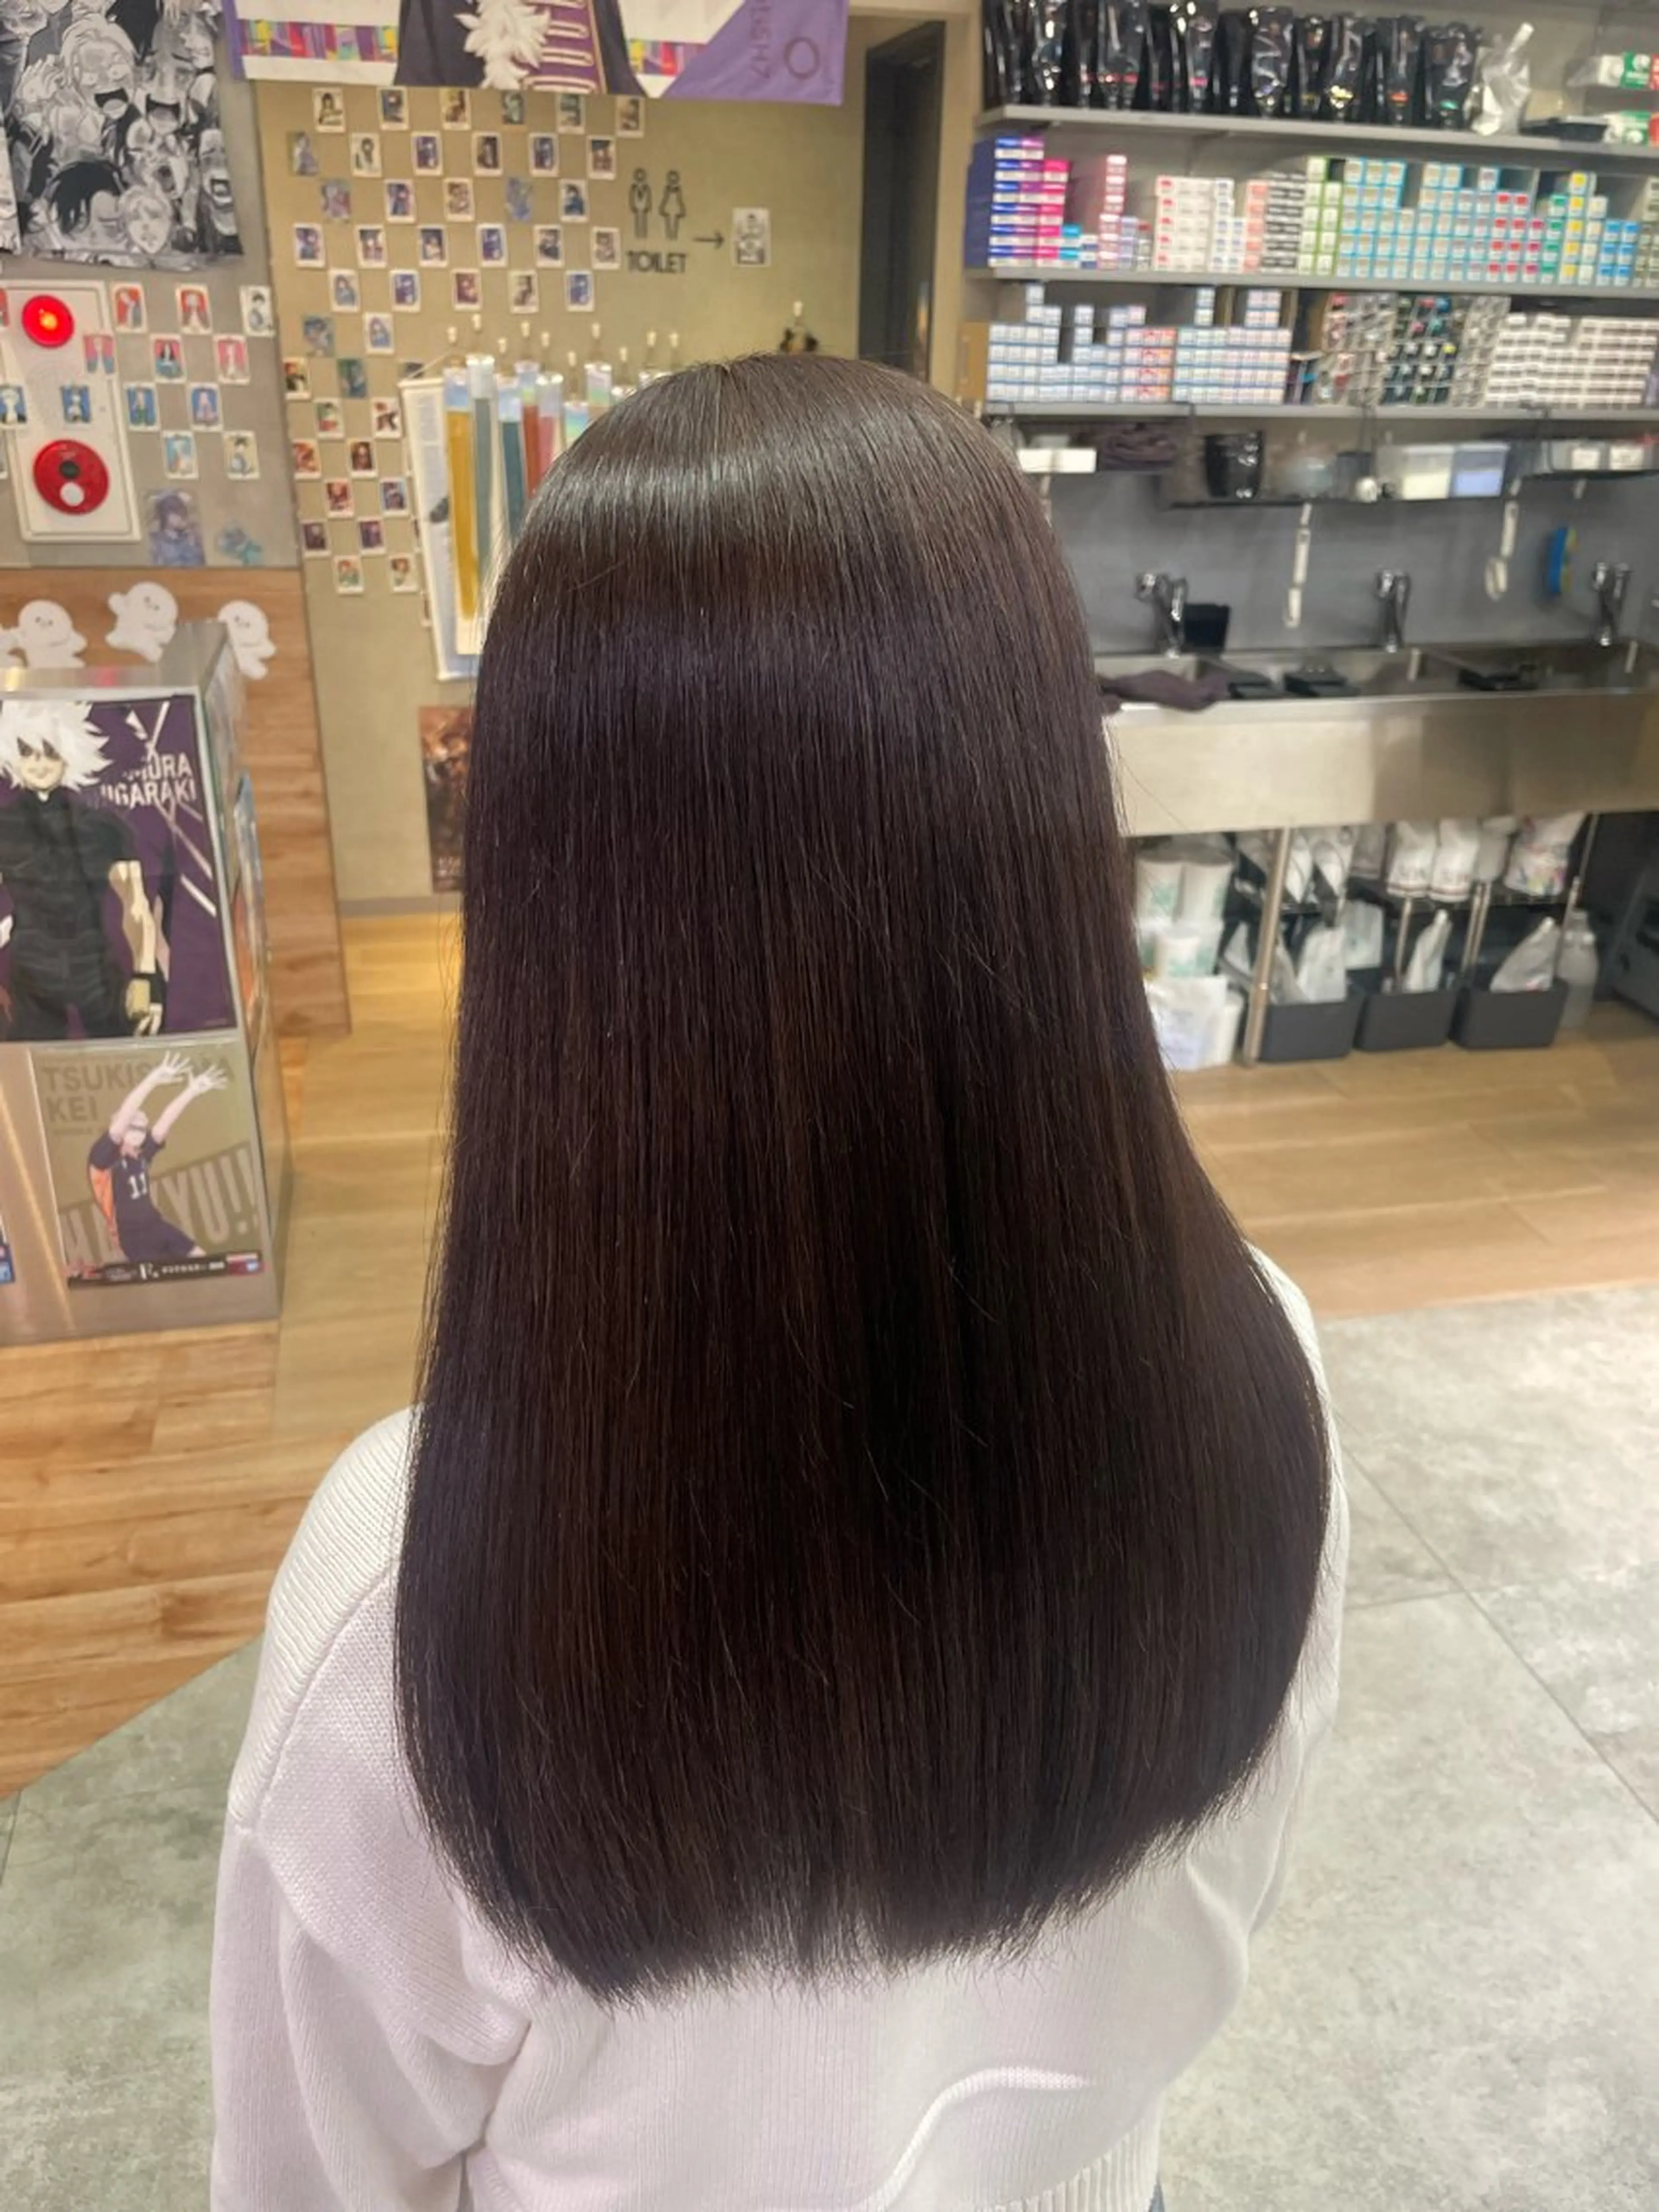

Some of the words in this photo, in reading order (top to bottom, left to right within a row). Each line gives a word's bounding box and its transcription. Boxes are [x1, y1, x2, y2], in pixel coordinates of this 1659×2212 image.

[627, 251, 686, 273] TOILET
[46, 1096, 98, 1122] KEI
[128, 1173, 148, 1200] 11
